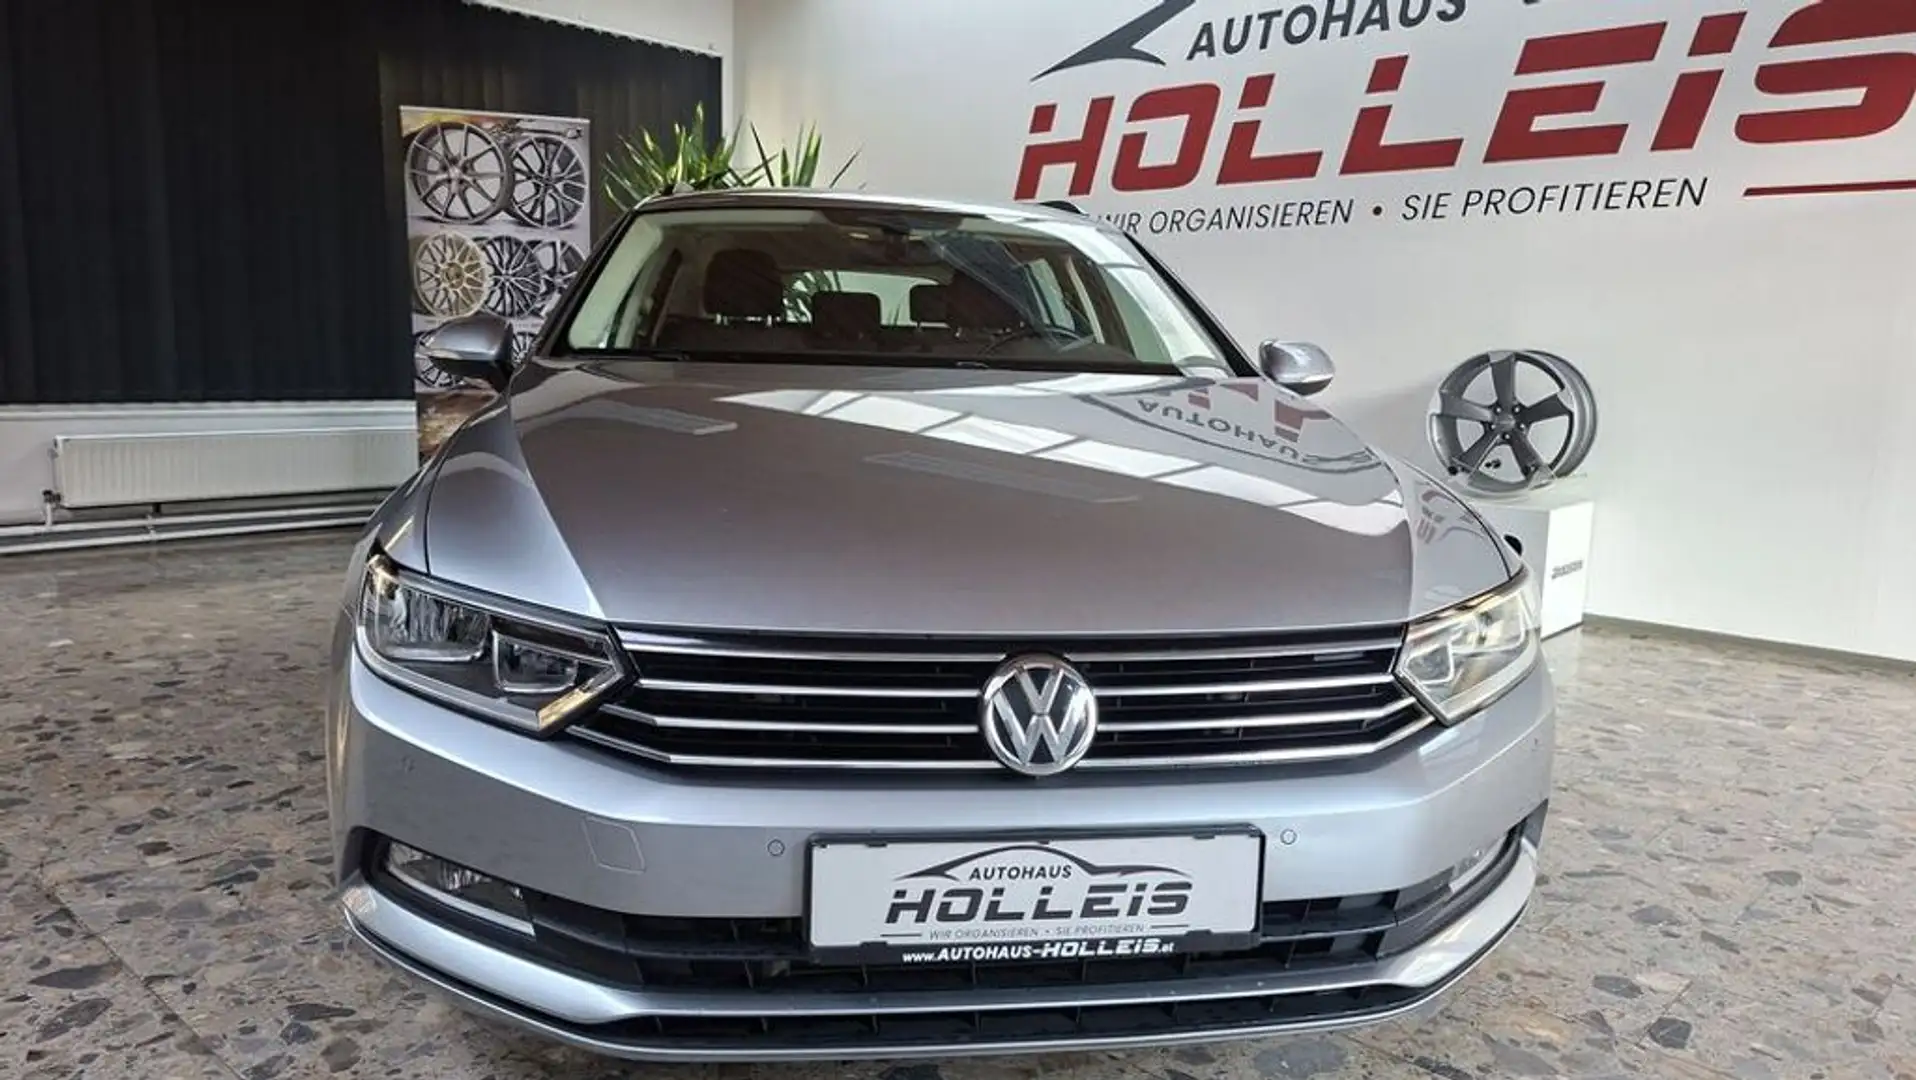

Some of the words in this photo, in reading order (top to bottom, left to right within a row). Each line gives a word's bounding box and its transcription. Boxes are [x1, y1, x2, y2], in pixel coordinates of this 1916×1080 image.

[1186, 0, 1467, 60] AUTOHAUS
[1014, 0, 1916, 200] HOLLEIS
[1149, 199, 1354, 234] ORGANISIEREN
[1402, 192, 1452, 220] SIE
[1461, 177, 1708, 216] PROFITIEREN
[968, 864, 1073, 881] AUTOHAUS
[884, 881, 1193, 924] HOLLEIS
[902, 937, 1176, 963] www.AUTOHAUS-HOLLEIS.at
[954, 926, 1039, 939] ORGANISIEREN
[1074, 923, 1145, 936] PROFITIEREN
